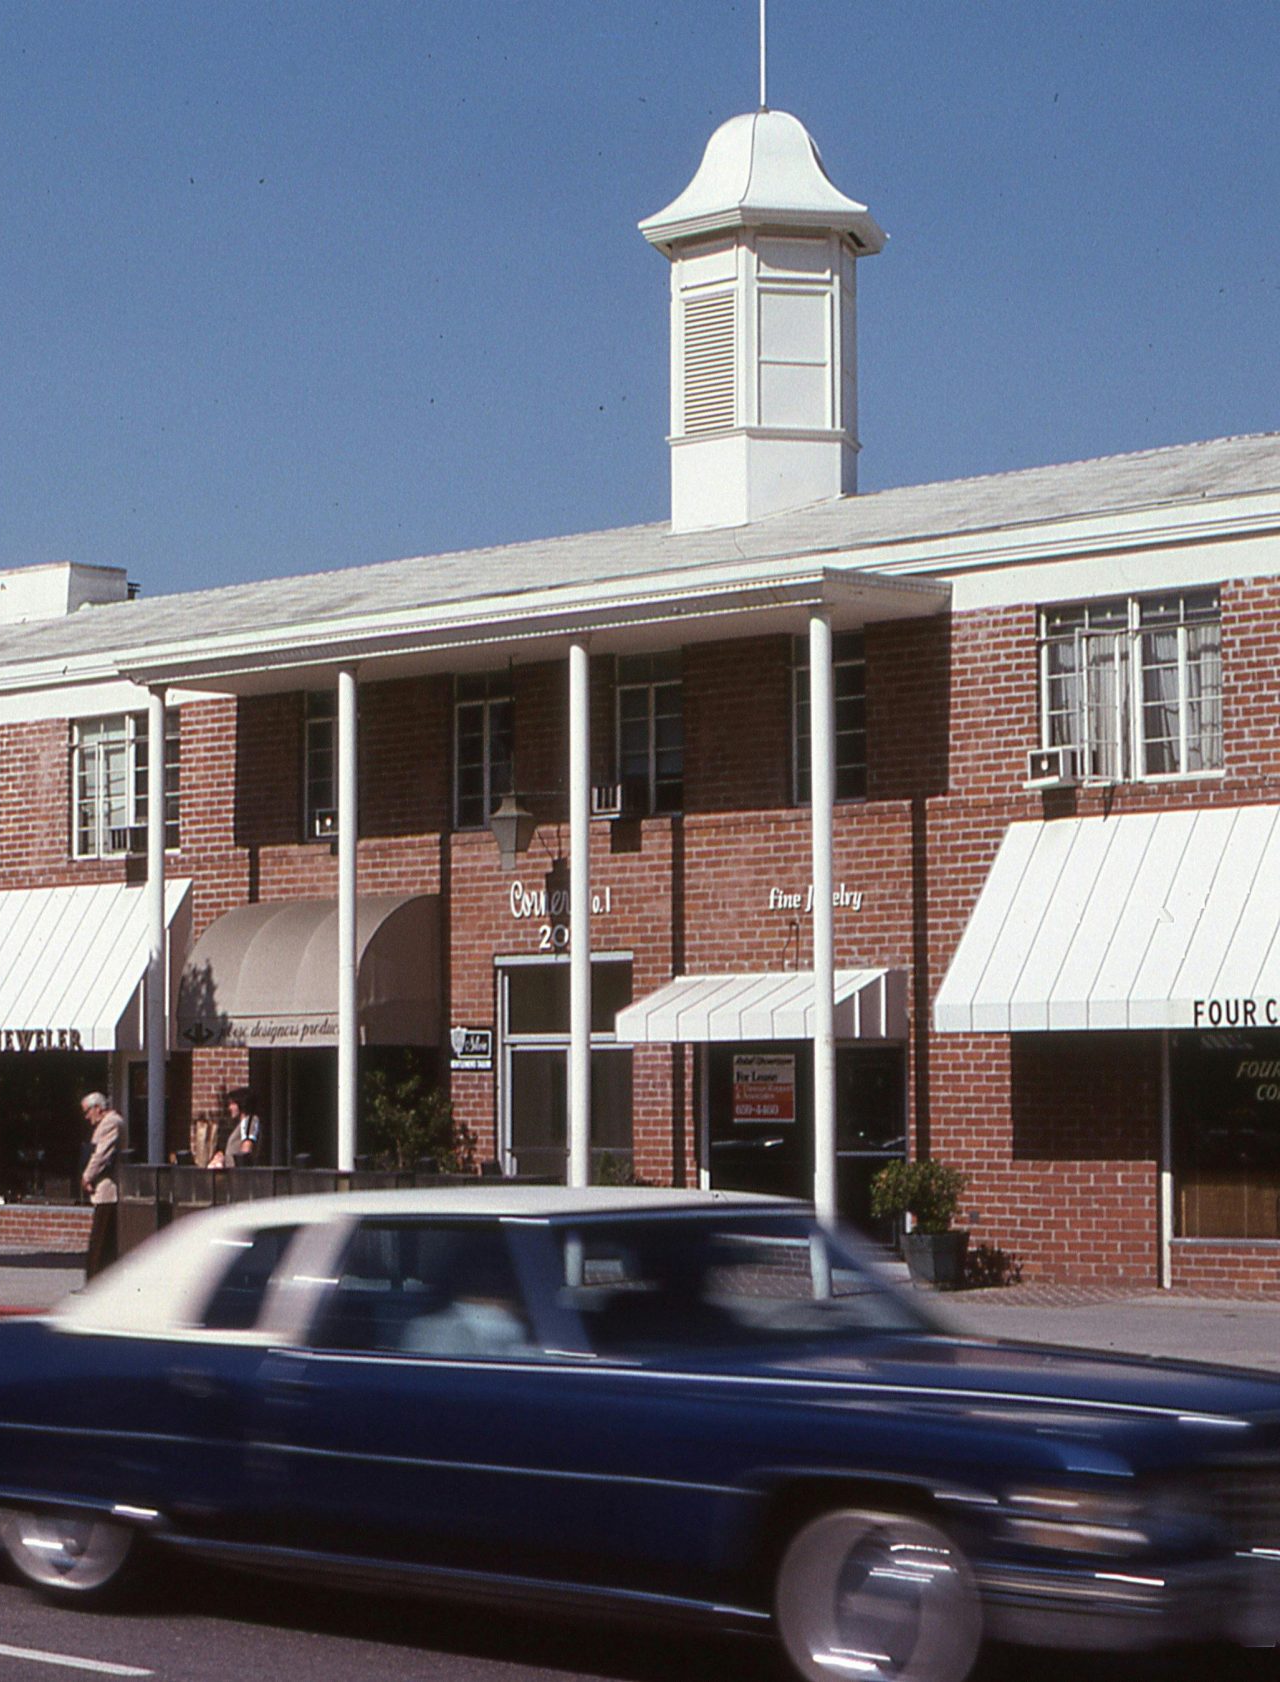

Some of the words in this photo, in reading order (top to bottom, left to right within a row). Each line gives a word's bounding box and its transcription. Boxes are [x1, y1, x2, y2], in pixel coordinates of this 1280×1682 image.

[769, 887, 802, 910] fine
[804, 882, 863, 913] Jelry
[539, 924, 570, 949] 20
[1193, 998, 1257, 1027] FOUR
[1256, 1083, 1280, 1101] CO
